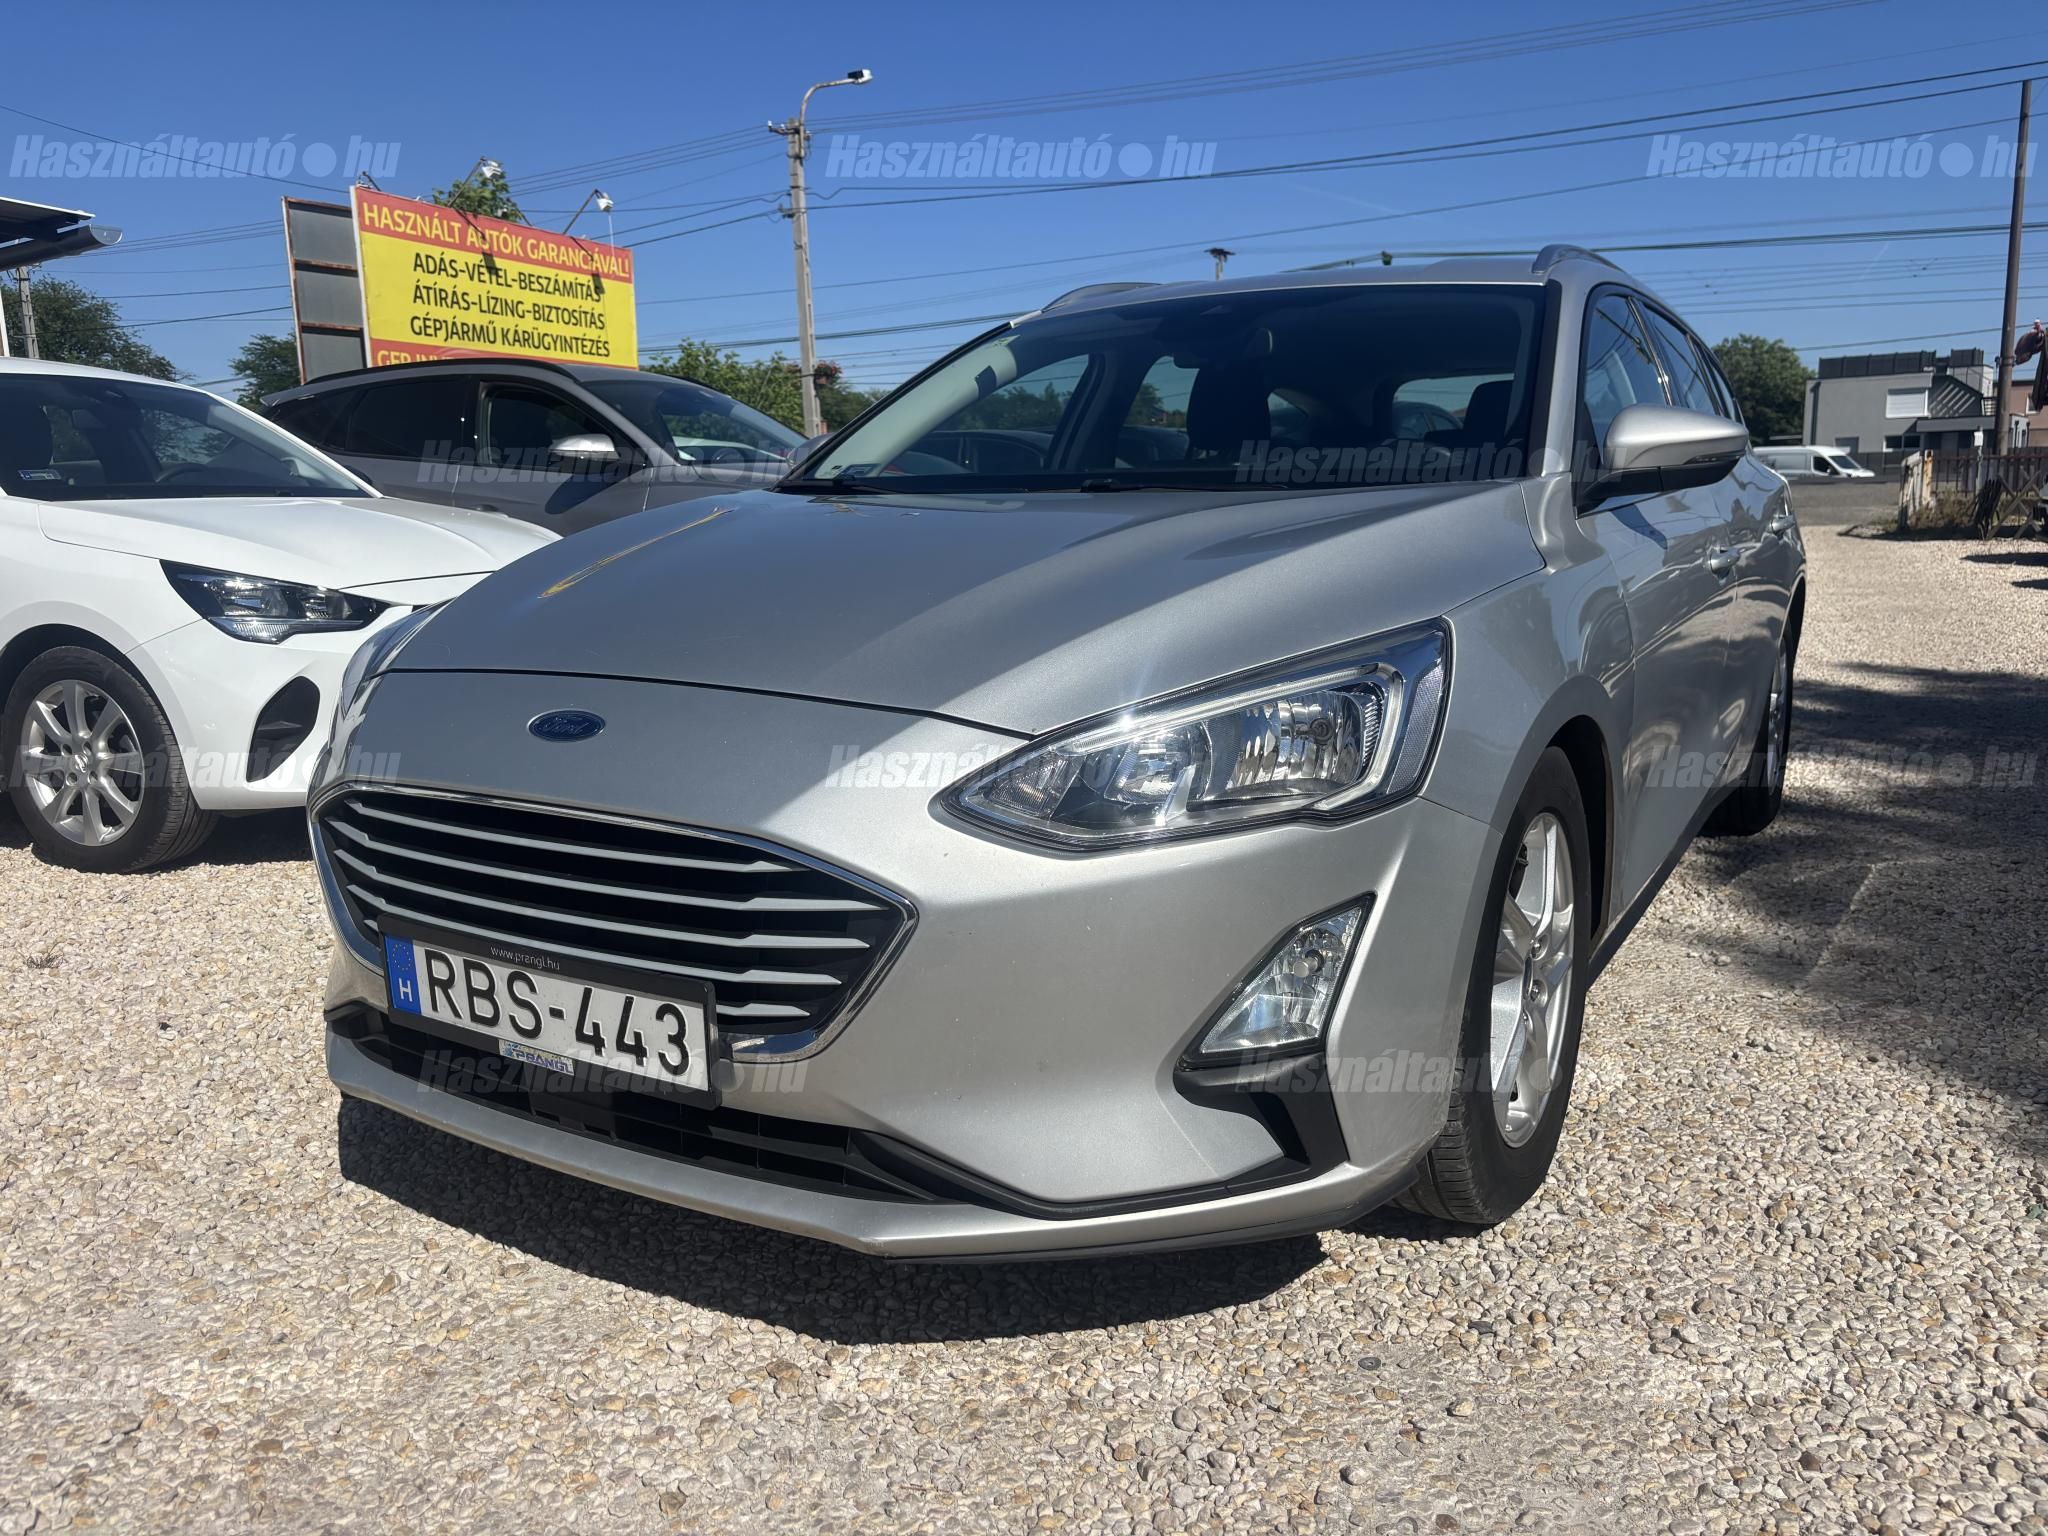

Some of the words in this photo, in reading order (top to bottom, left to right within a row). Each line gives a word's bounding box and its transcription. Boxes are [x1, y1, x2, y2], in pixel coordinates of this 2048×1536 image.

[363, 202, 461, 245] HASZNÁLT
[467, 226, 524, 257] AUTÓK
[526, 239, 630, 278] GARANCIÁVAL!
[413, 252, 601, 303] ADÁS-VÉTEL-BESZÁMÍTÁS
[413, 281, 605, 330] ÁTÍRÁS-LÍZING-BIZTOSÍTÁS
[410, 315, 497, 345] GÉPJÁRMŰ
[501, 326, 610, 358] KÁRÜGYINTÉZÉS
[490, 946, 560, 970] www.prangl.hu
[398, 978, 413, 1002] H
[424, 948, 691, 1076] RBS-443
